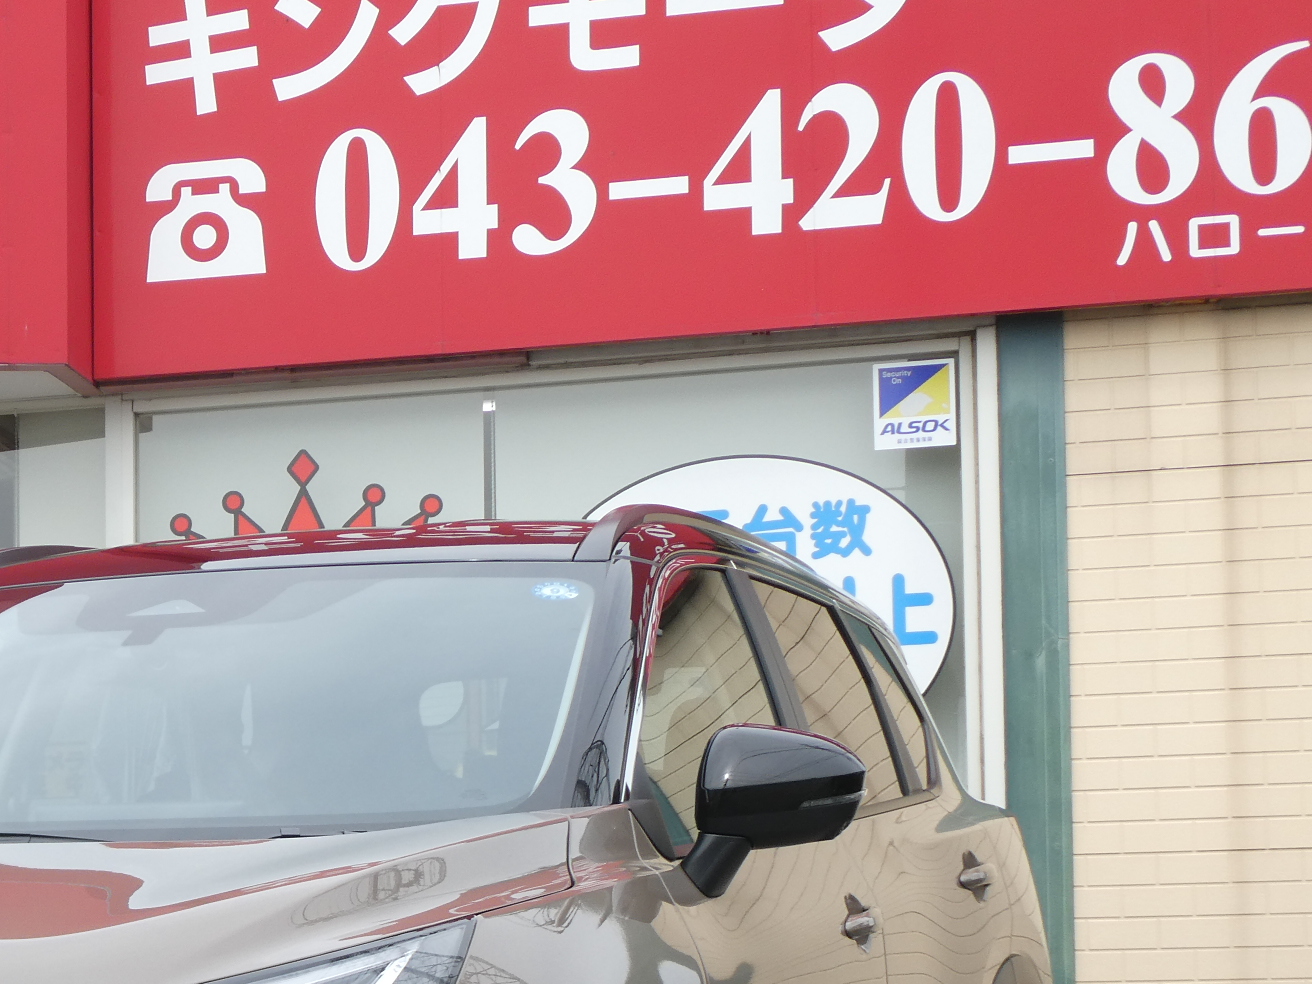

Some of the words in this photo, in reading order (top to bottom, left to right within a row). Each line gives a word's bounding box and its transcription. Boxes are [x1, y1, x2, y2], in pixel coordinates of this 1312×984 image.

[1116, 214, 1306, 266] ハロー
[880, 418, 950, 435] ALSOK
[698, 498, 873, 560] 台数
